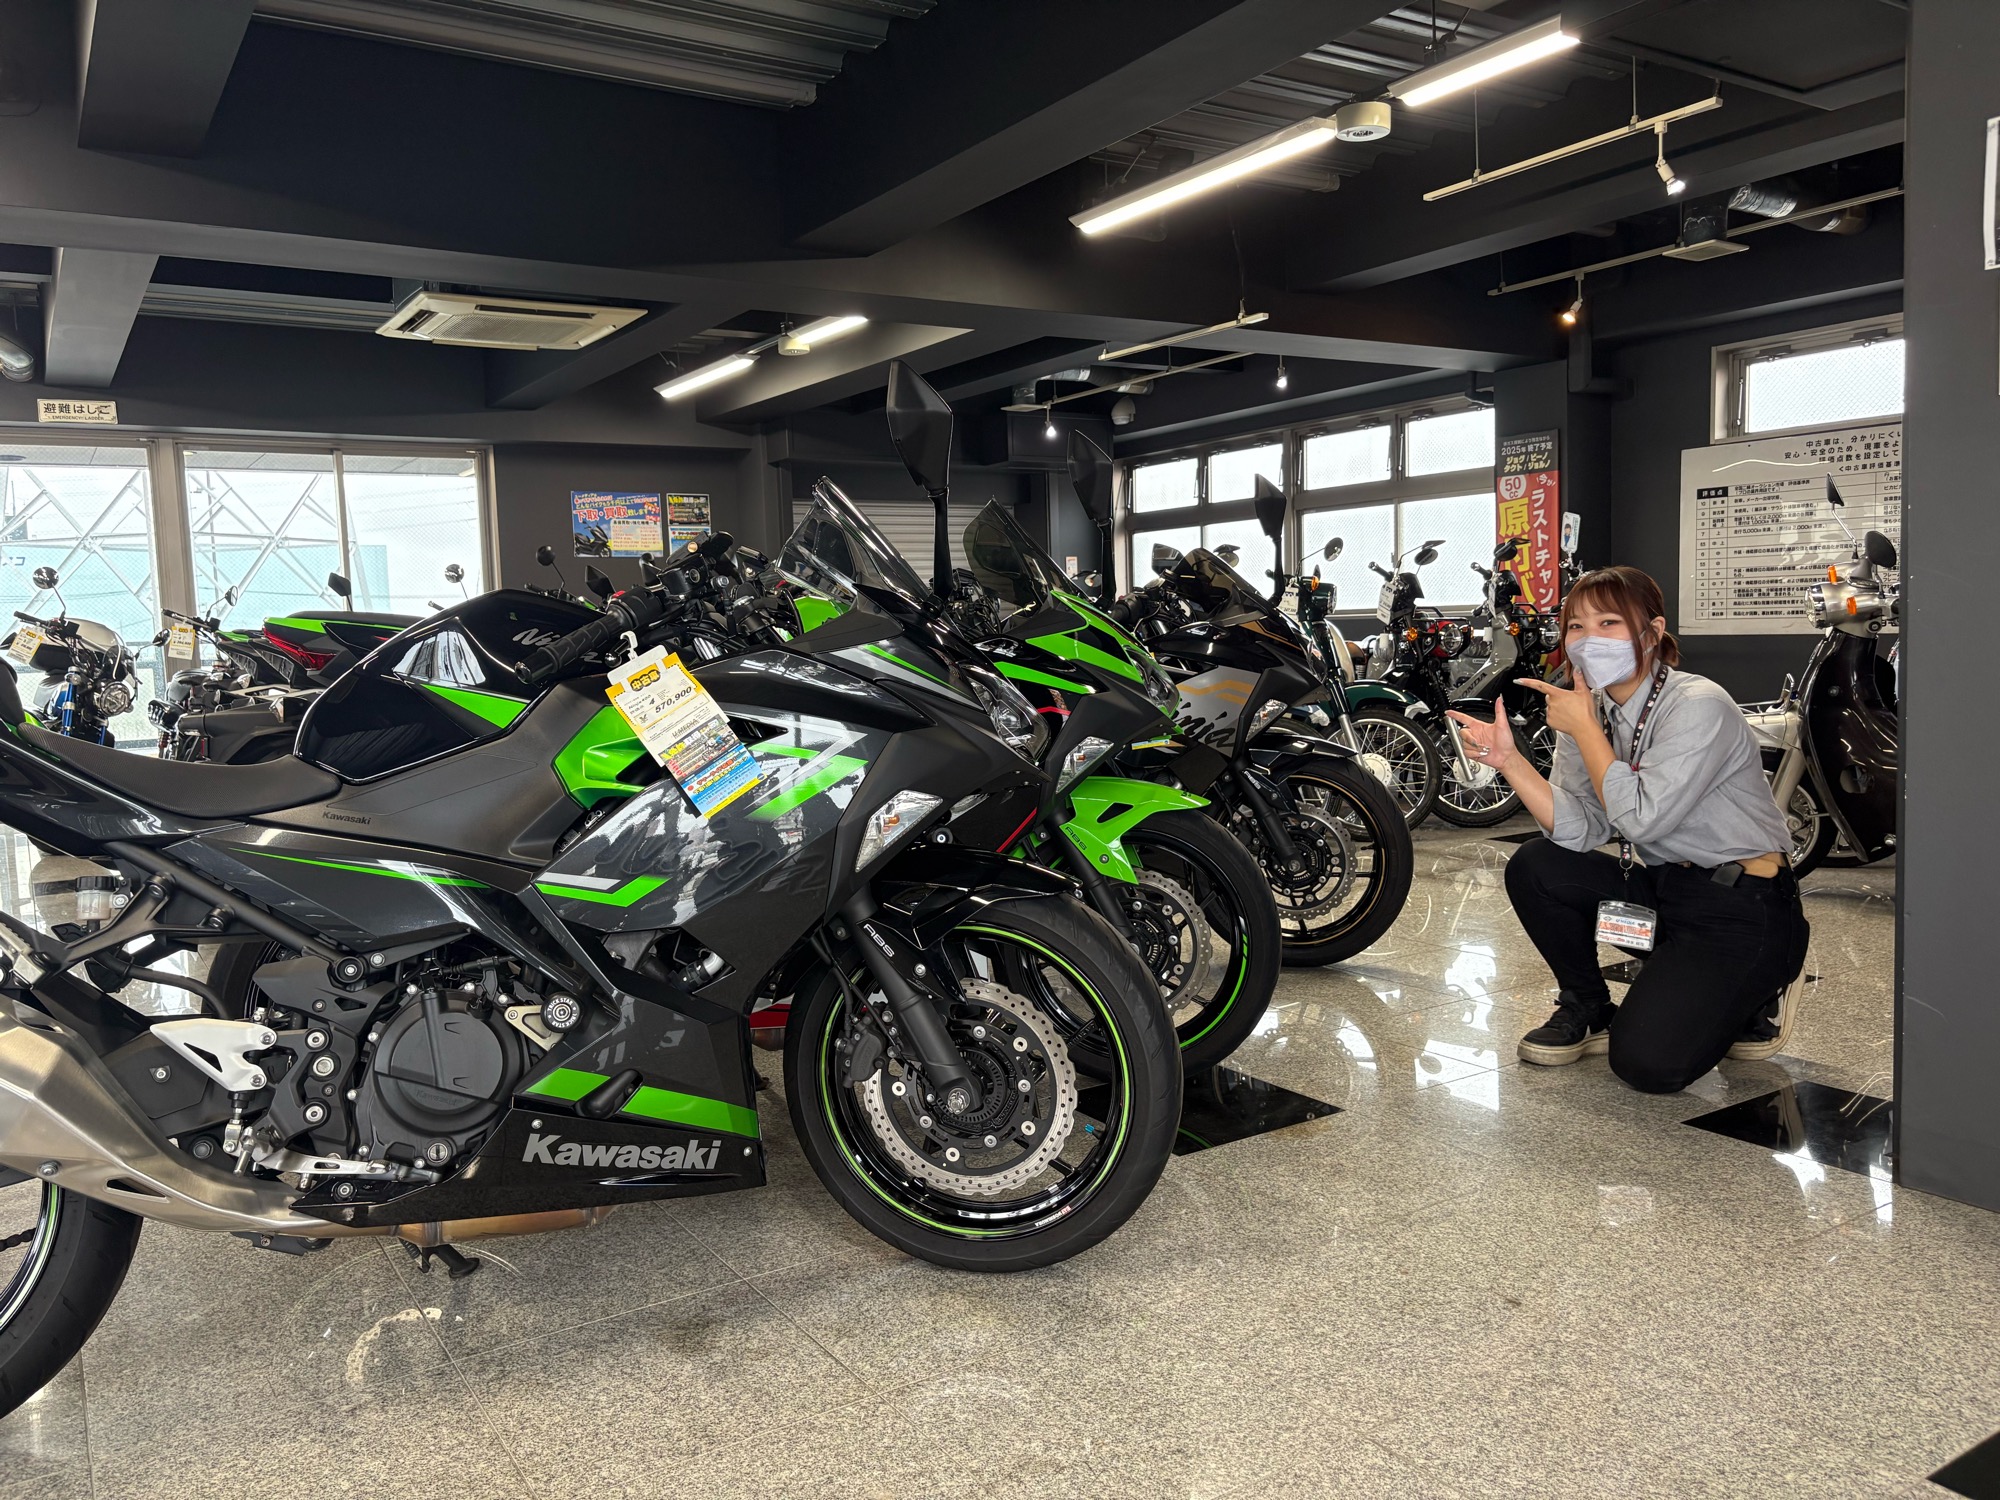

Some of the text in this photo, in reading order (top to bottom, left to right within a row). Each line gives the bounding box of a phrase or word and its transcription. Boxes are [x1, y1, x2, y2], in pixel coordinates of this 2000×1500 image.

[43, 402, 111, 415] 避難はしご
[1504, 476, 1521, 492] 50
[512, 627, 603, 664] Nia
[630, 669, 661, 691] 中古車
[1461, 672, 1488, 698] ONDA
[649, 697, 656, 705] 4
[655, 686, 692, 714] 570,900
[322, 810, 372, 825] Kawasaki
[863, 923, 895, 958] ABS
[547, 997, 574, 1012] TRICK STAR
[522, 1133, 722, 1170] Kawasaki
